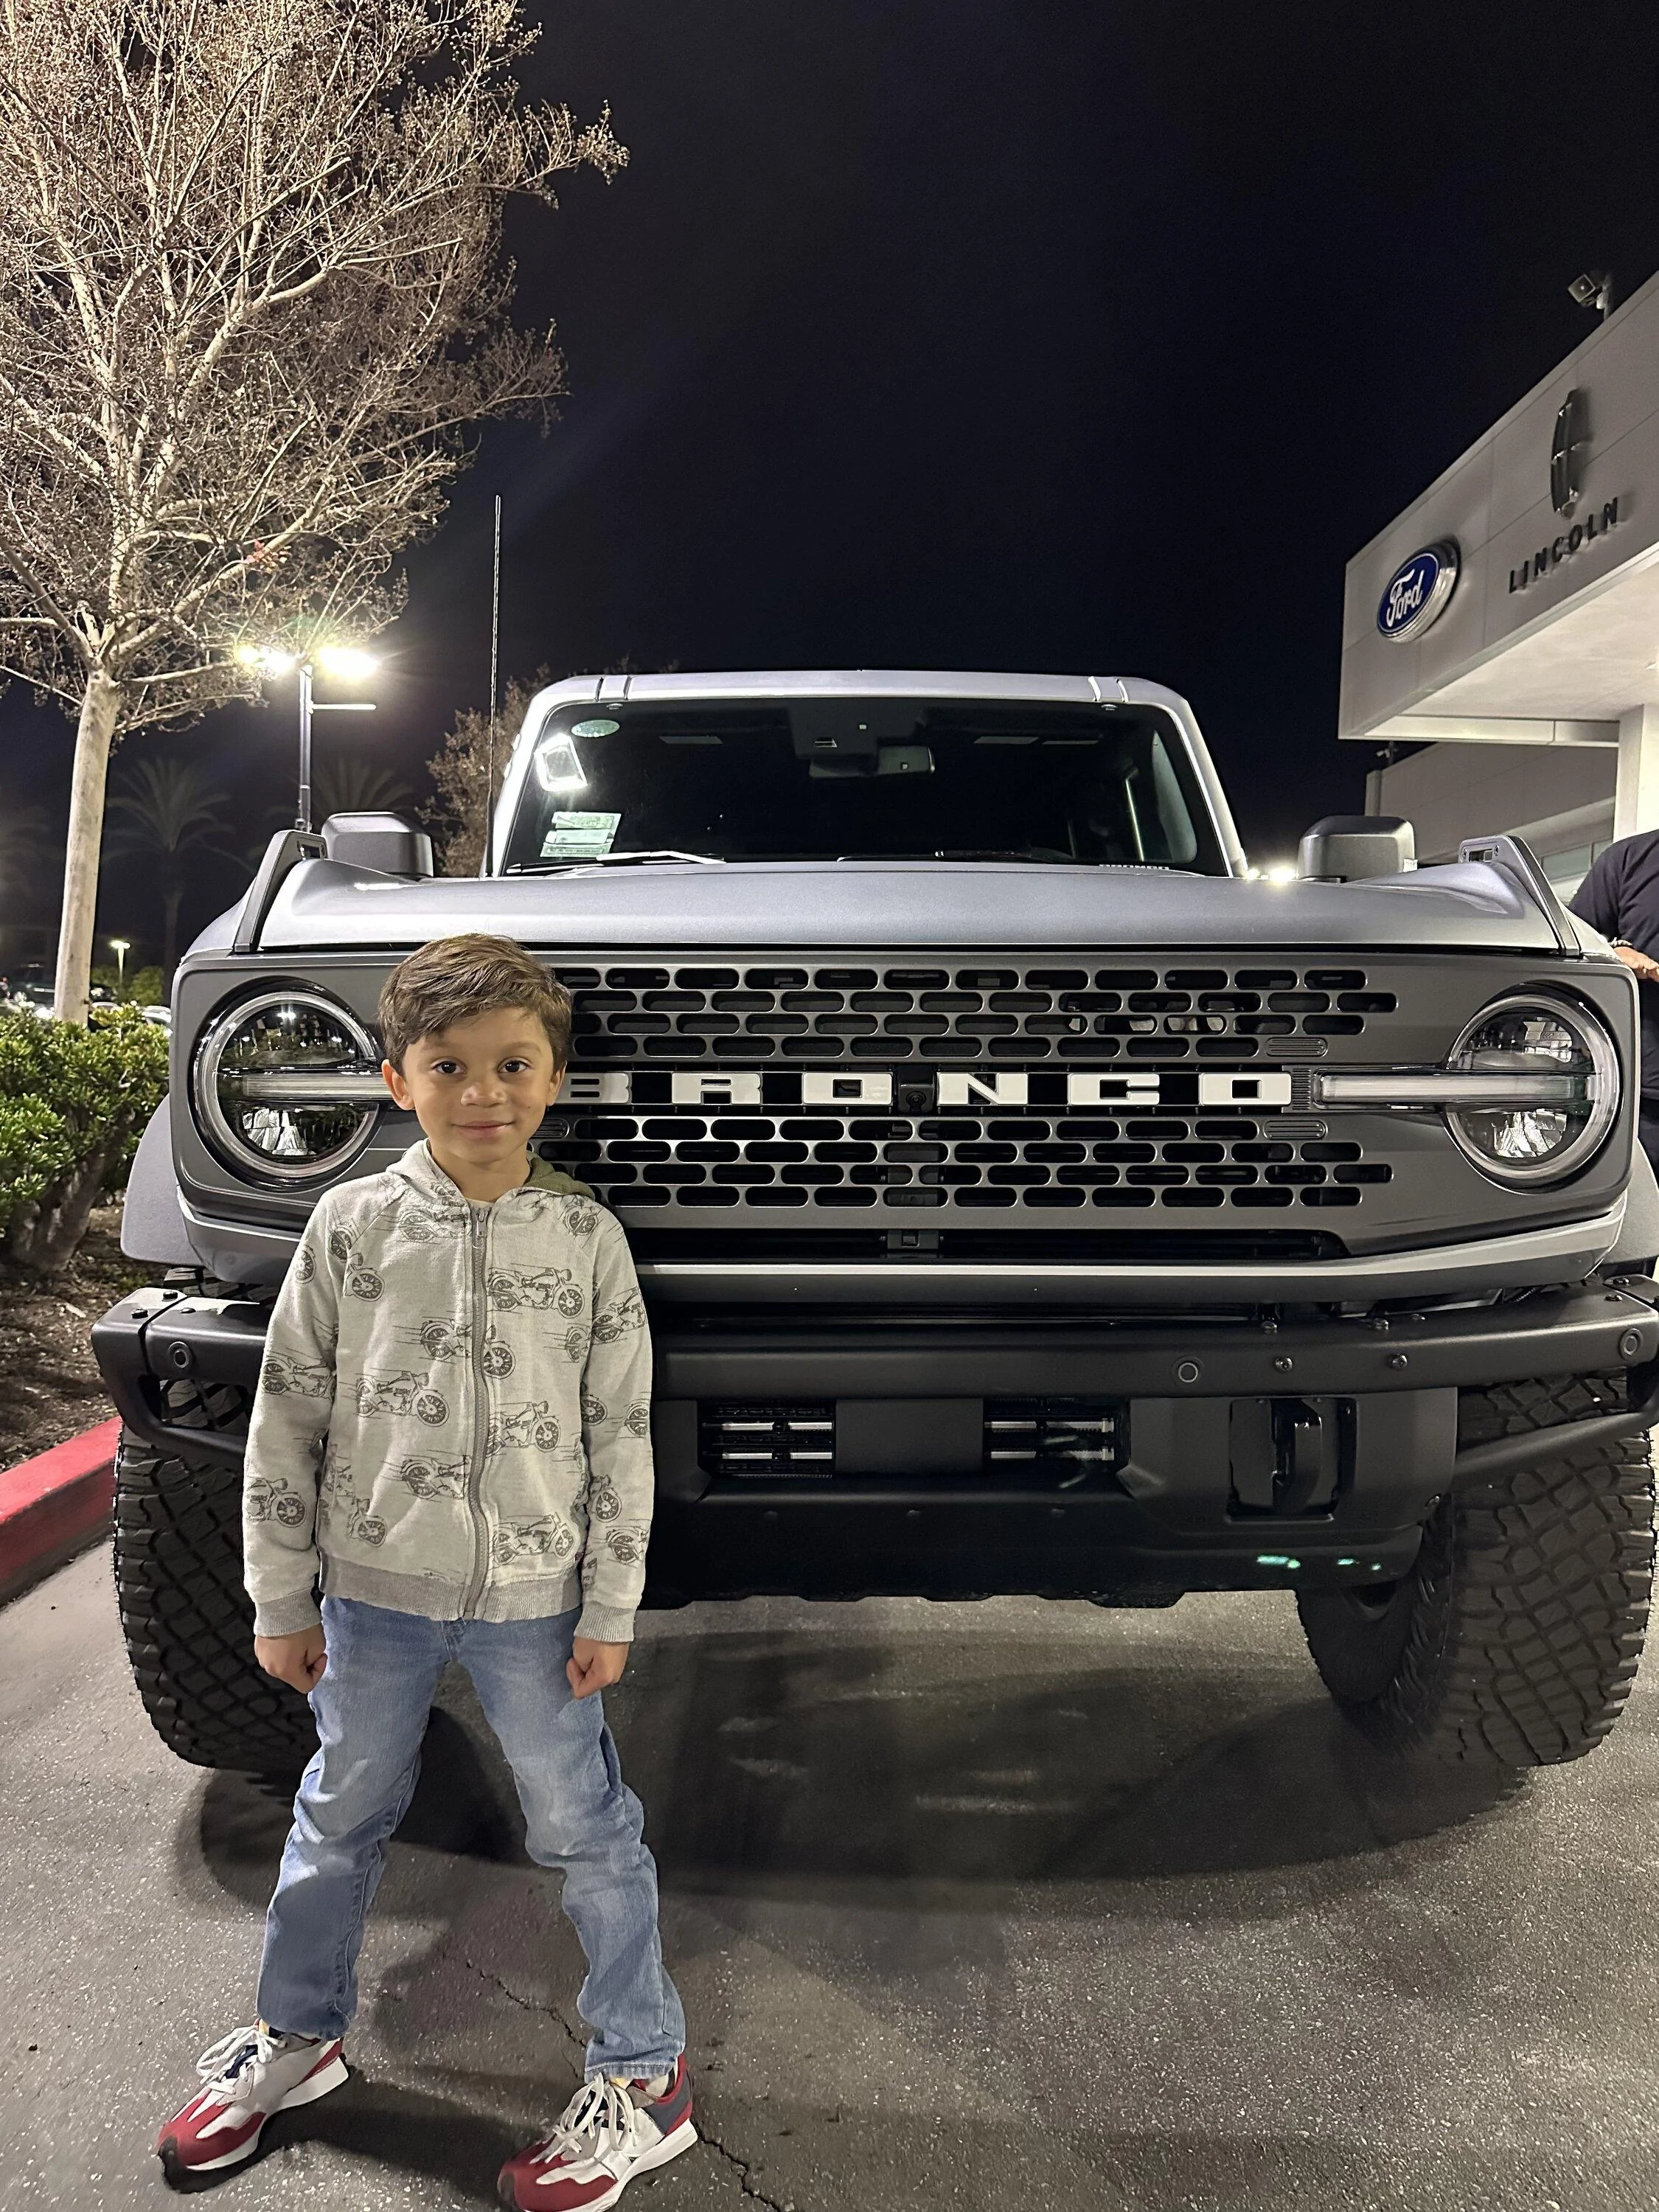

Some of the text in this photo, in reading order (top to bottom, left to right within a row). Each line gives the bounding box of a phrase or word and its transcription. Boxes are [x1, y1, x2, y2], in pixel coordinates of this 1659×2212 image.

[1509, 497, 1618, 594] LINCOLN
[1386, 568, 1425, 627] Ford
[554, 1071, 1291, 1105] BRONCO
